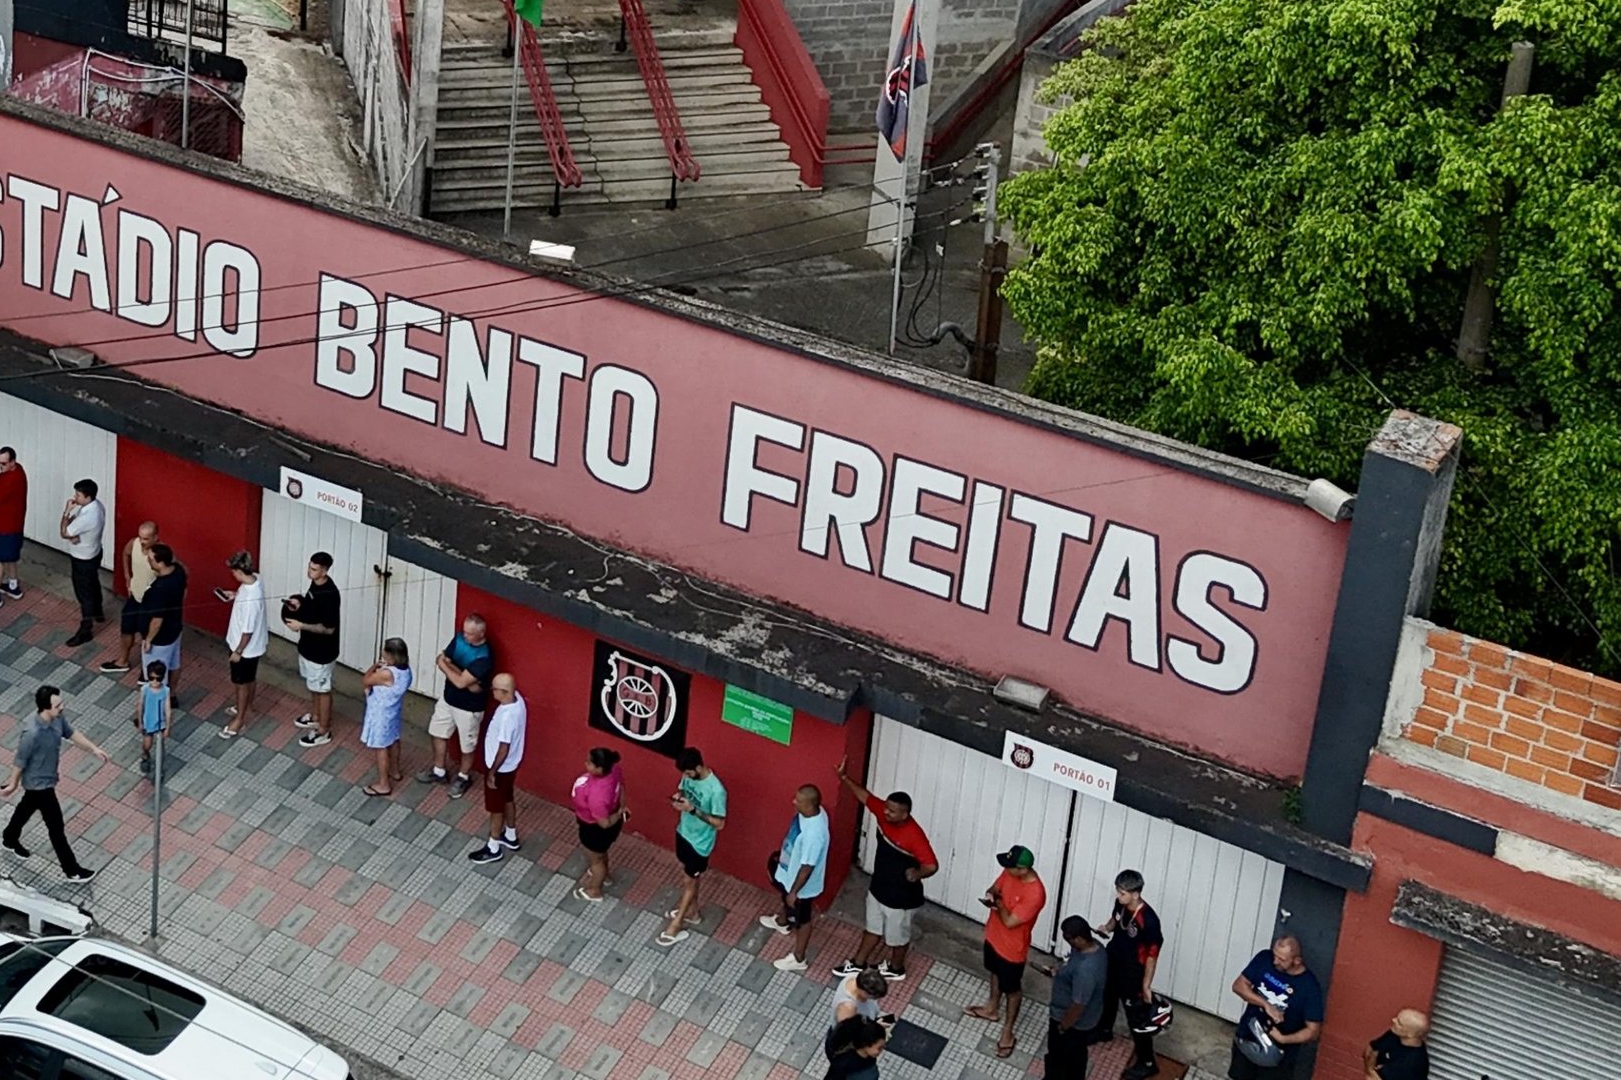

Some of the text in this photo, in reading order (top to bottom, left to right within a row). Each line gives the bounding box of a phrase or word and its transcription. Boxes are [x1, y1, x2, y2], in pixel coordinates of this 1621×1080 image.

[315, 272, 659, 494] BENTO
[719, 401, 1268, 695] FREITAS
[348, 502, 358, 513] 02
[1053, 762, 1110, 791] PORTÃO 01
